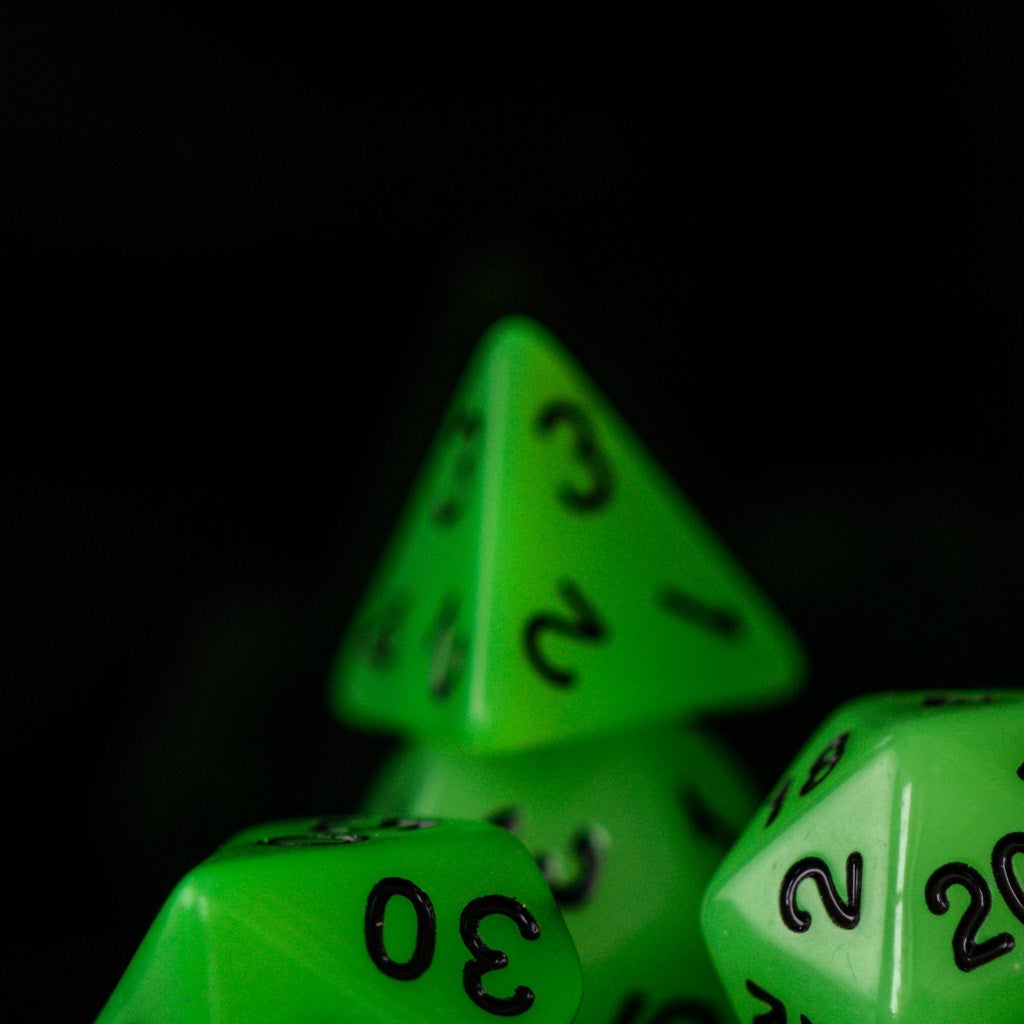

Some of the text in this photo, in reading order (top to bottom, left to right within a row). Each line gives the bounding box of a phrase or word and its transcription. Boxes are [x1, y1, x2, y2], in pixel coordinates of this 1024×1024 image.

[533, 402, 613, 510] 3
[522, 579, 608, 690] 2
[364, 876, 541, 1017] 30
[780, 851, 864, 933] 2
